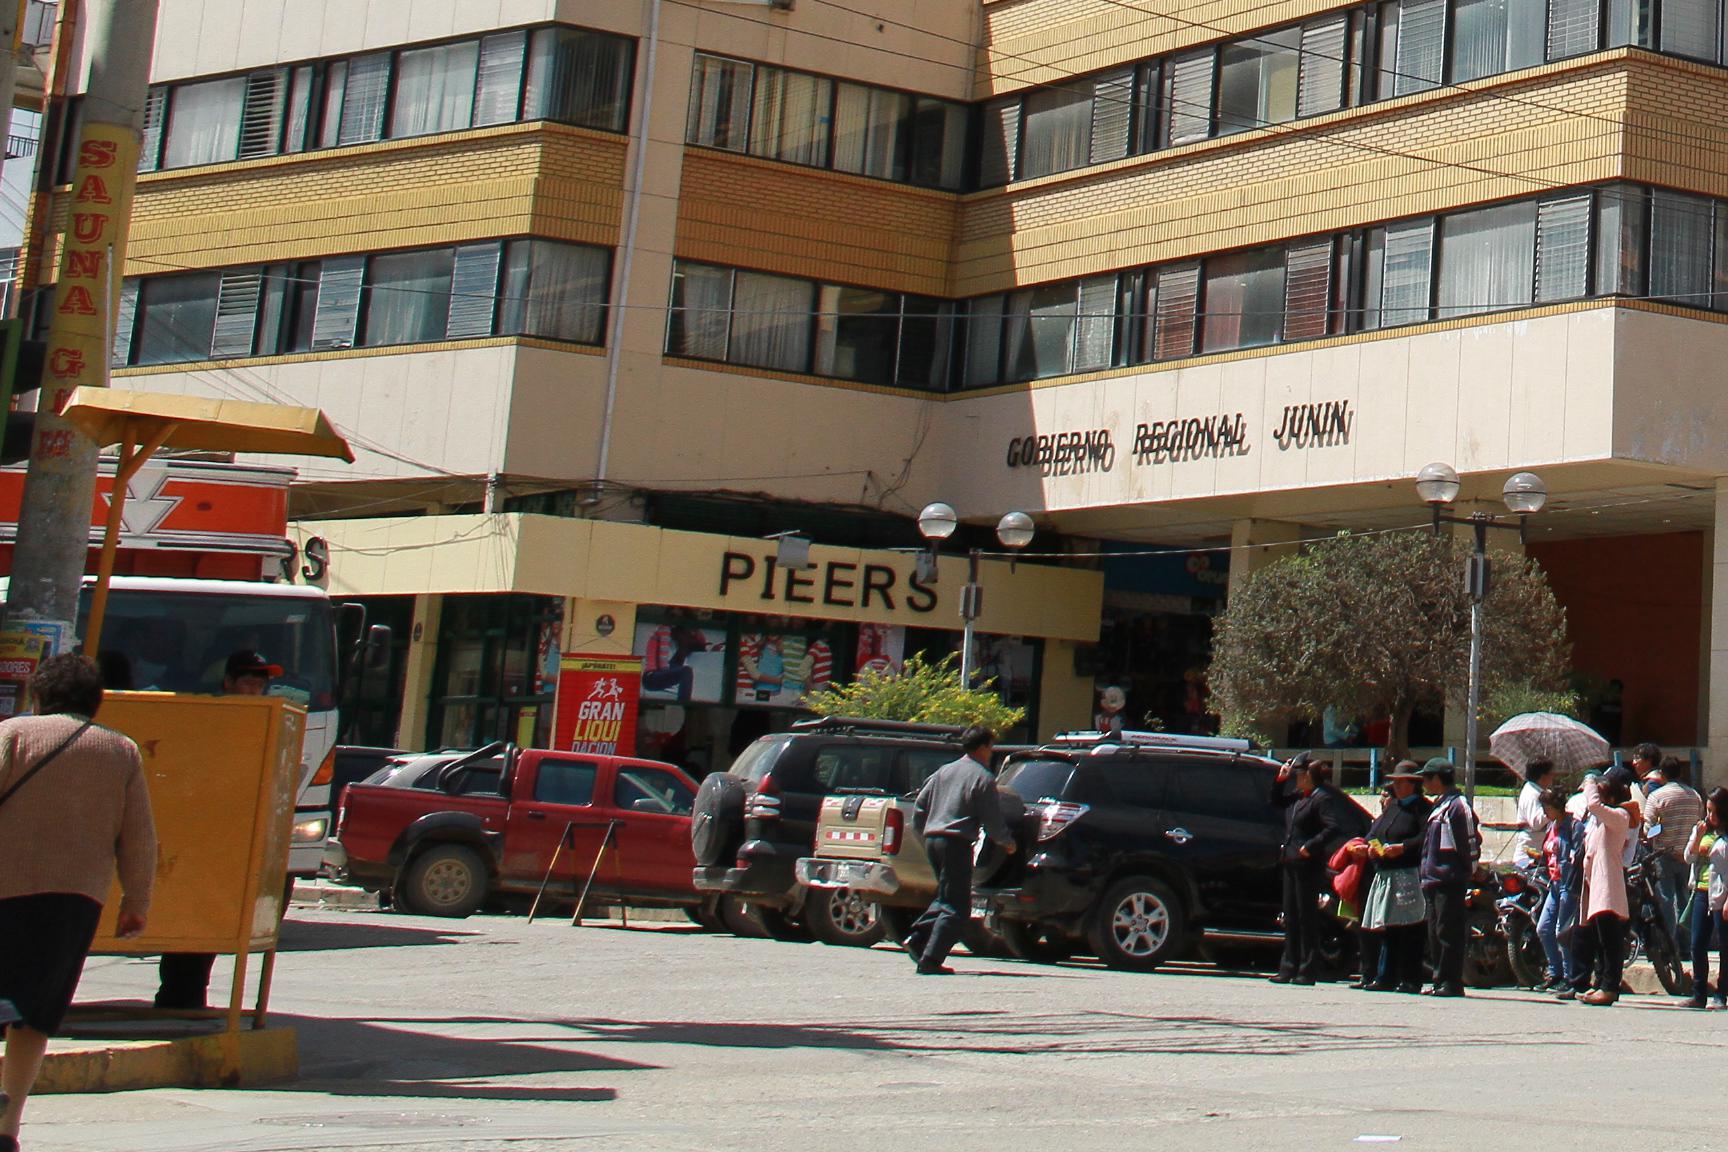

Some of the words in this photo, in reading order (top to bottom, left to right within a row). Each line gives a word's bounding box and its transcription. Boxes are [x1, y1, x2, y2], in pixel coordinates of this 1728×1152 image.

[1006, 428, 1112, 468] GOBIERNO
[1132, 413, 1243, 455] REGIONAL
[719, 551, 938, 612] PIEERS
[578, 701, 625, 720] GRAN
